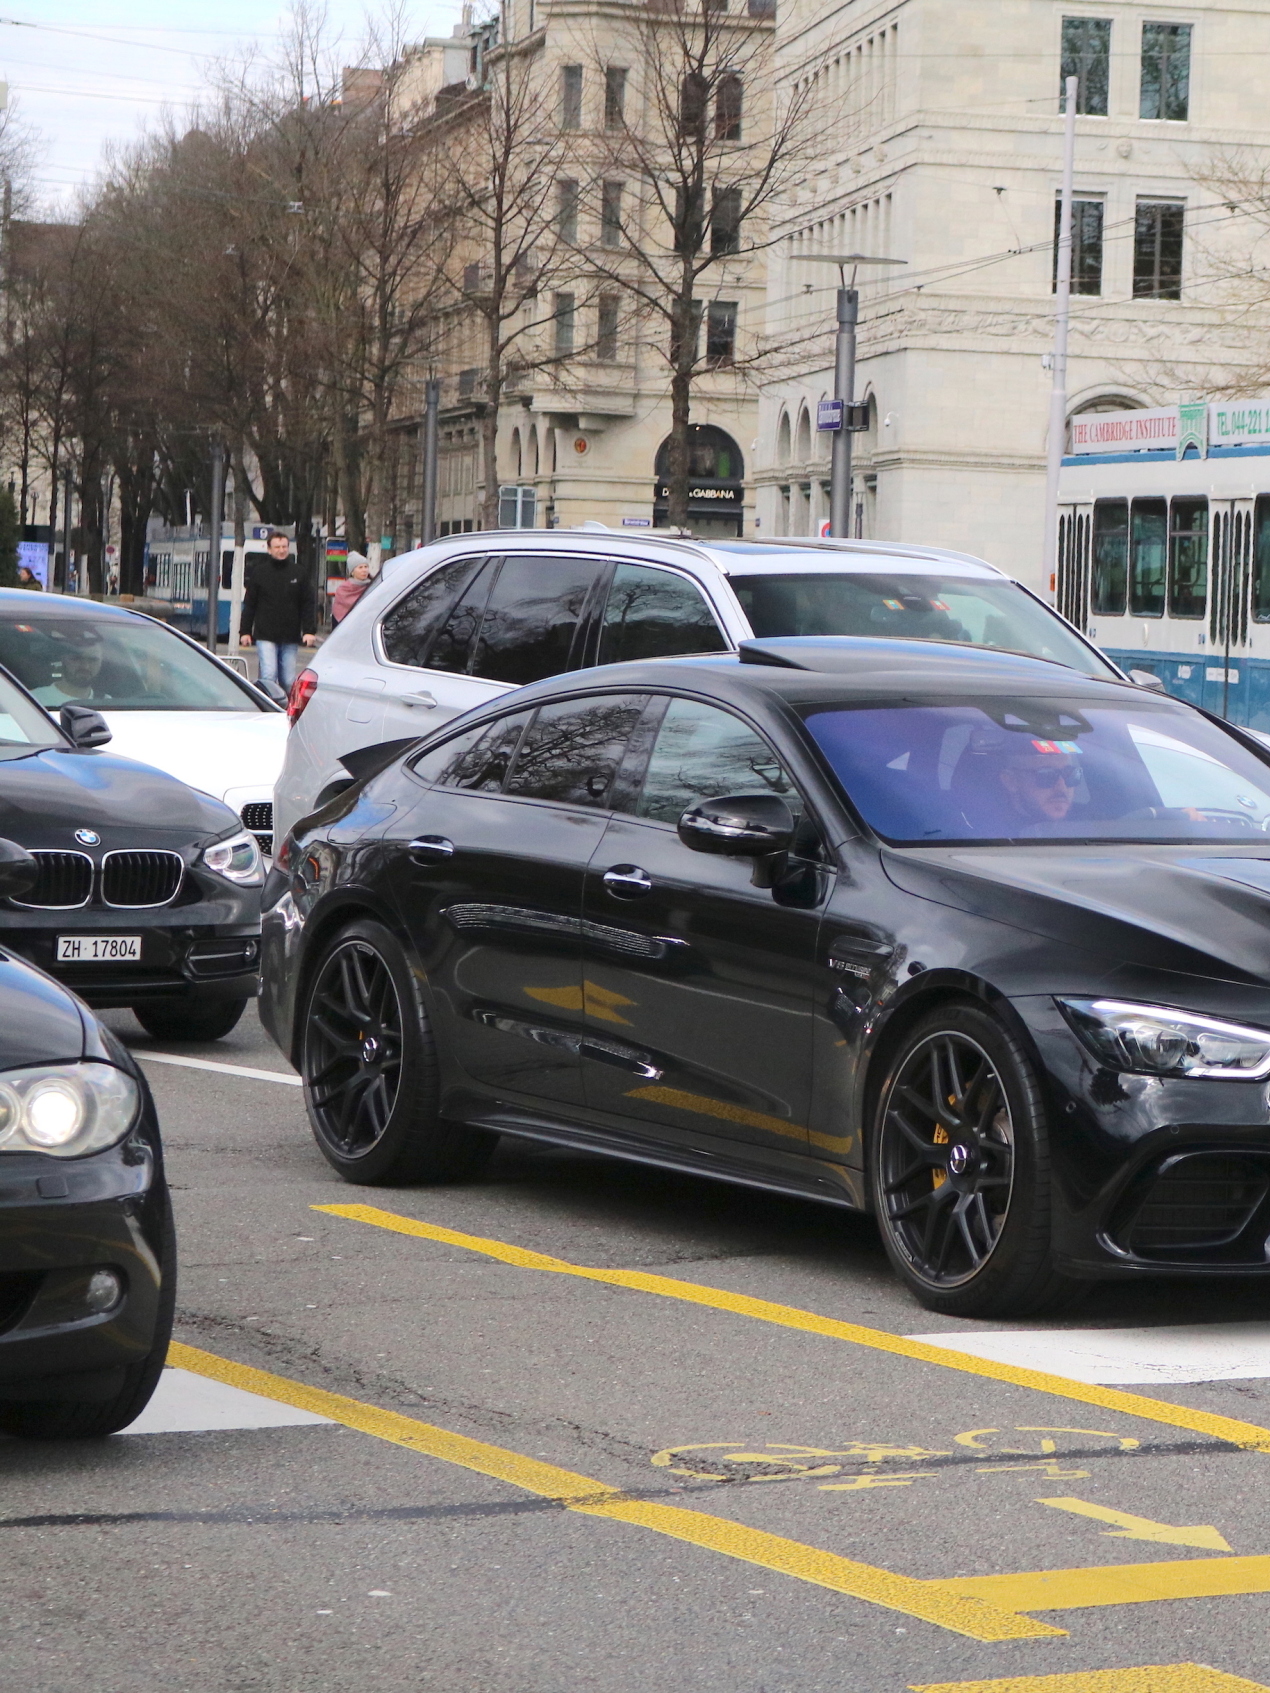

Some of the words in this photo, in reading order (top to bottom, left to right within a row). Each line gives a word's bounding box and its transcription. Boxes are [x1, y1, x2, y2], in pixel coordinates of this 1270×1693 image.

[1074, 424, 1087, 444] THE
[1089, 420, 1133, 443] CAMBRIDGE
[1135, 416, 1177, 440] INSTITUTE
[1231, 409, 1262, 436] 044-221
[693, 488, 734, 499] GABBANA
[260, 527, 268, 540] 9
[62, 940, 81, 958] ZH
[92, 939, 137, 958] 17804
